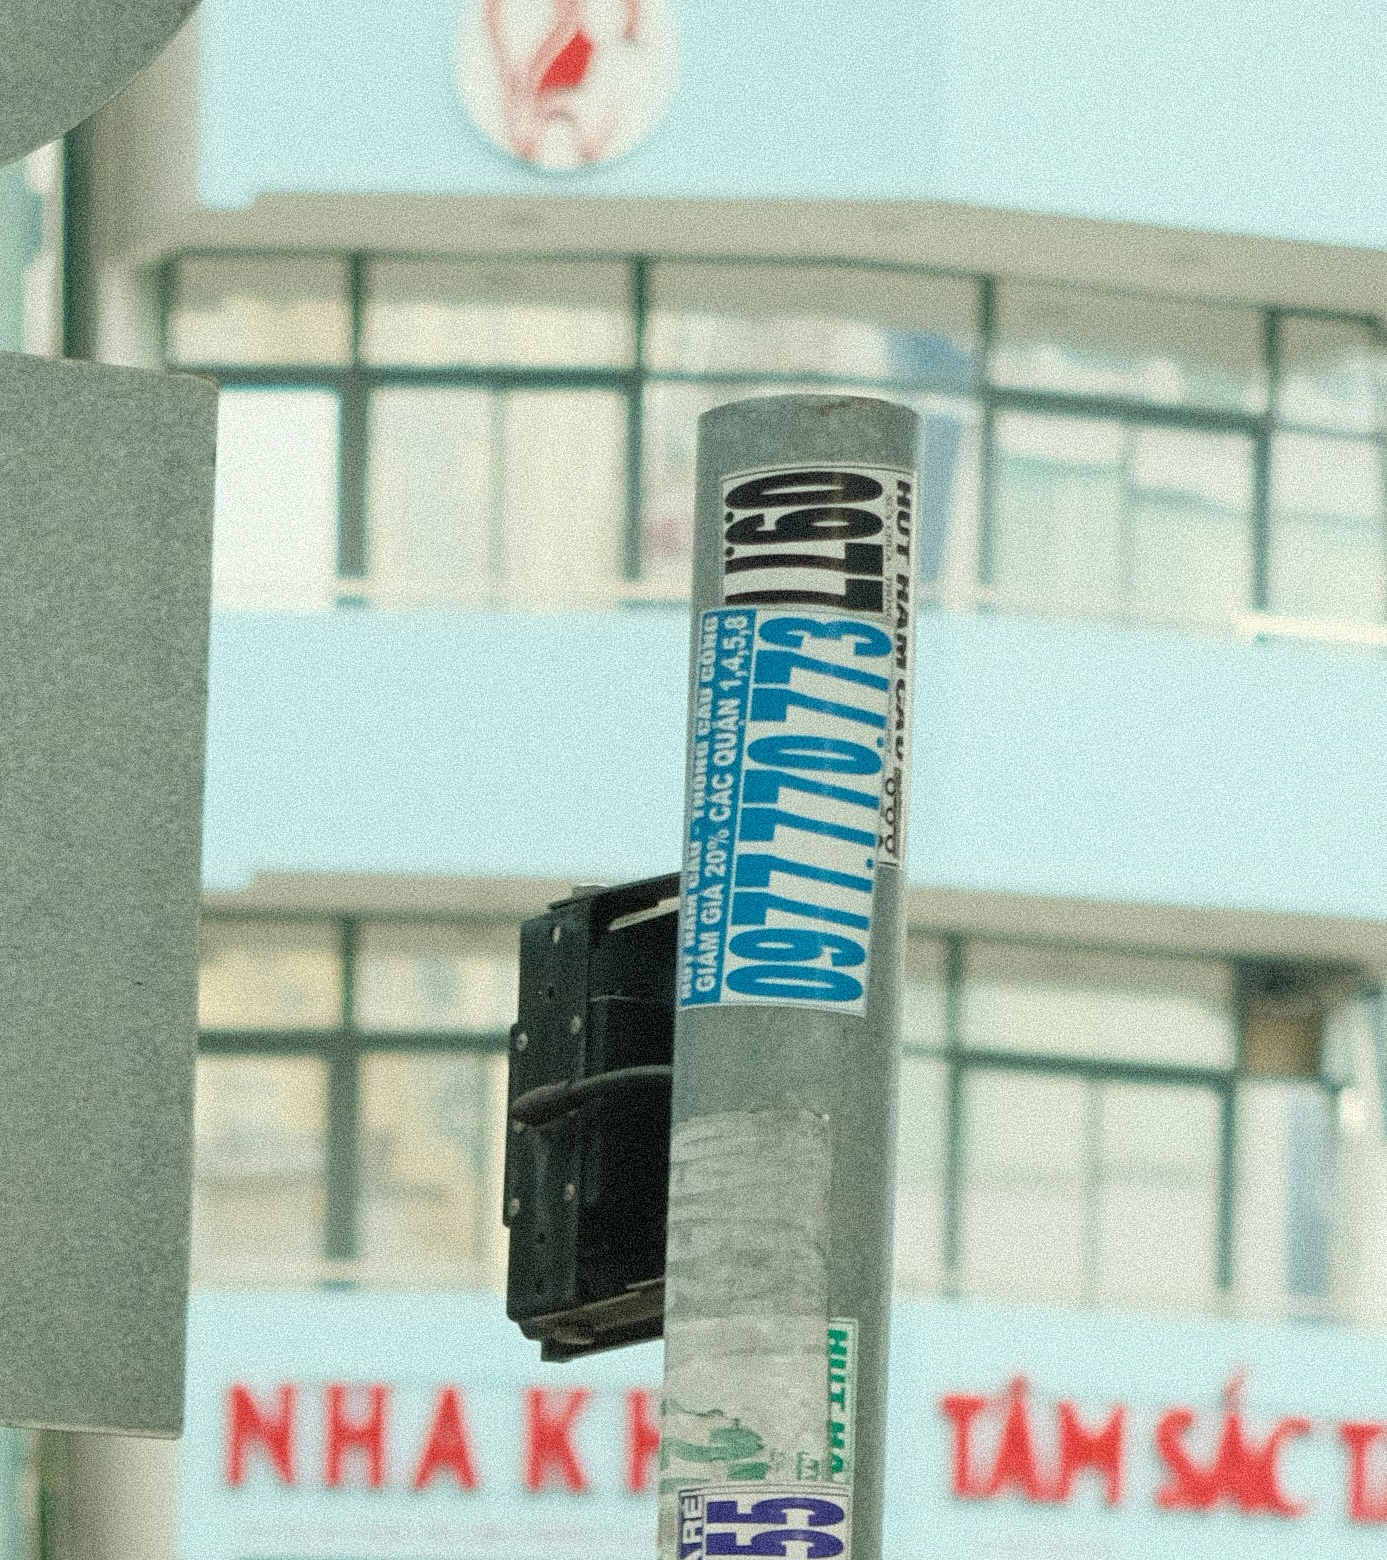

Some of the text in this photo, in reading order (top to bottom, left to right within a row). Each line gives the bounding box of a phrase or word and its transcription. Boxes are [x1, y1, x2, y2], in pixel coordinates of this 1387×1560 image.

[721, 615, 750, 691] 1,4,5,8
[711, 698, 745, 767] QUẬN
[705, 773, 734, 822] CÁC
[726, 616, 892, 1002] 0977.770.773
[704, 828, 731, 878] 20%
[940, 1373, 1126, 1508] TÂM
